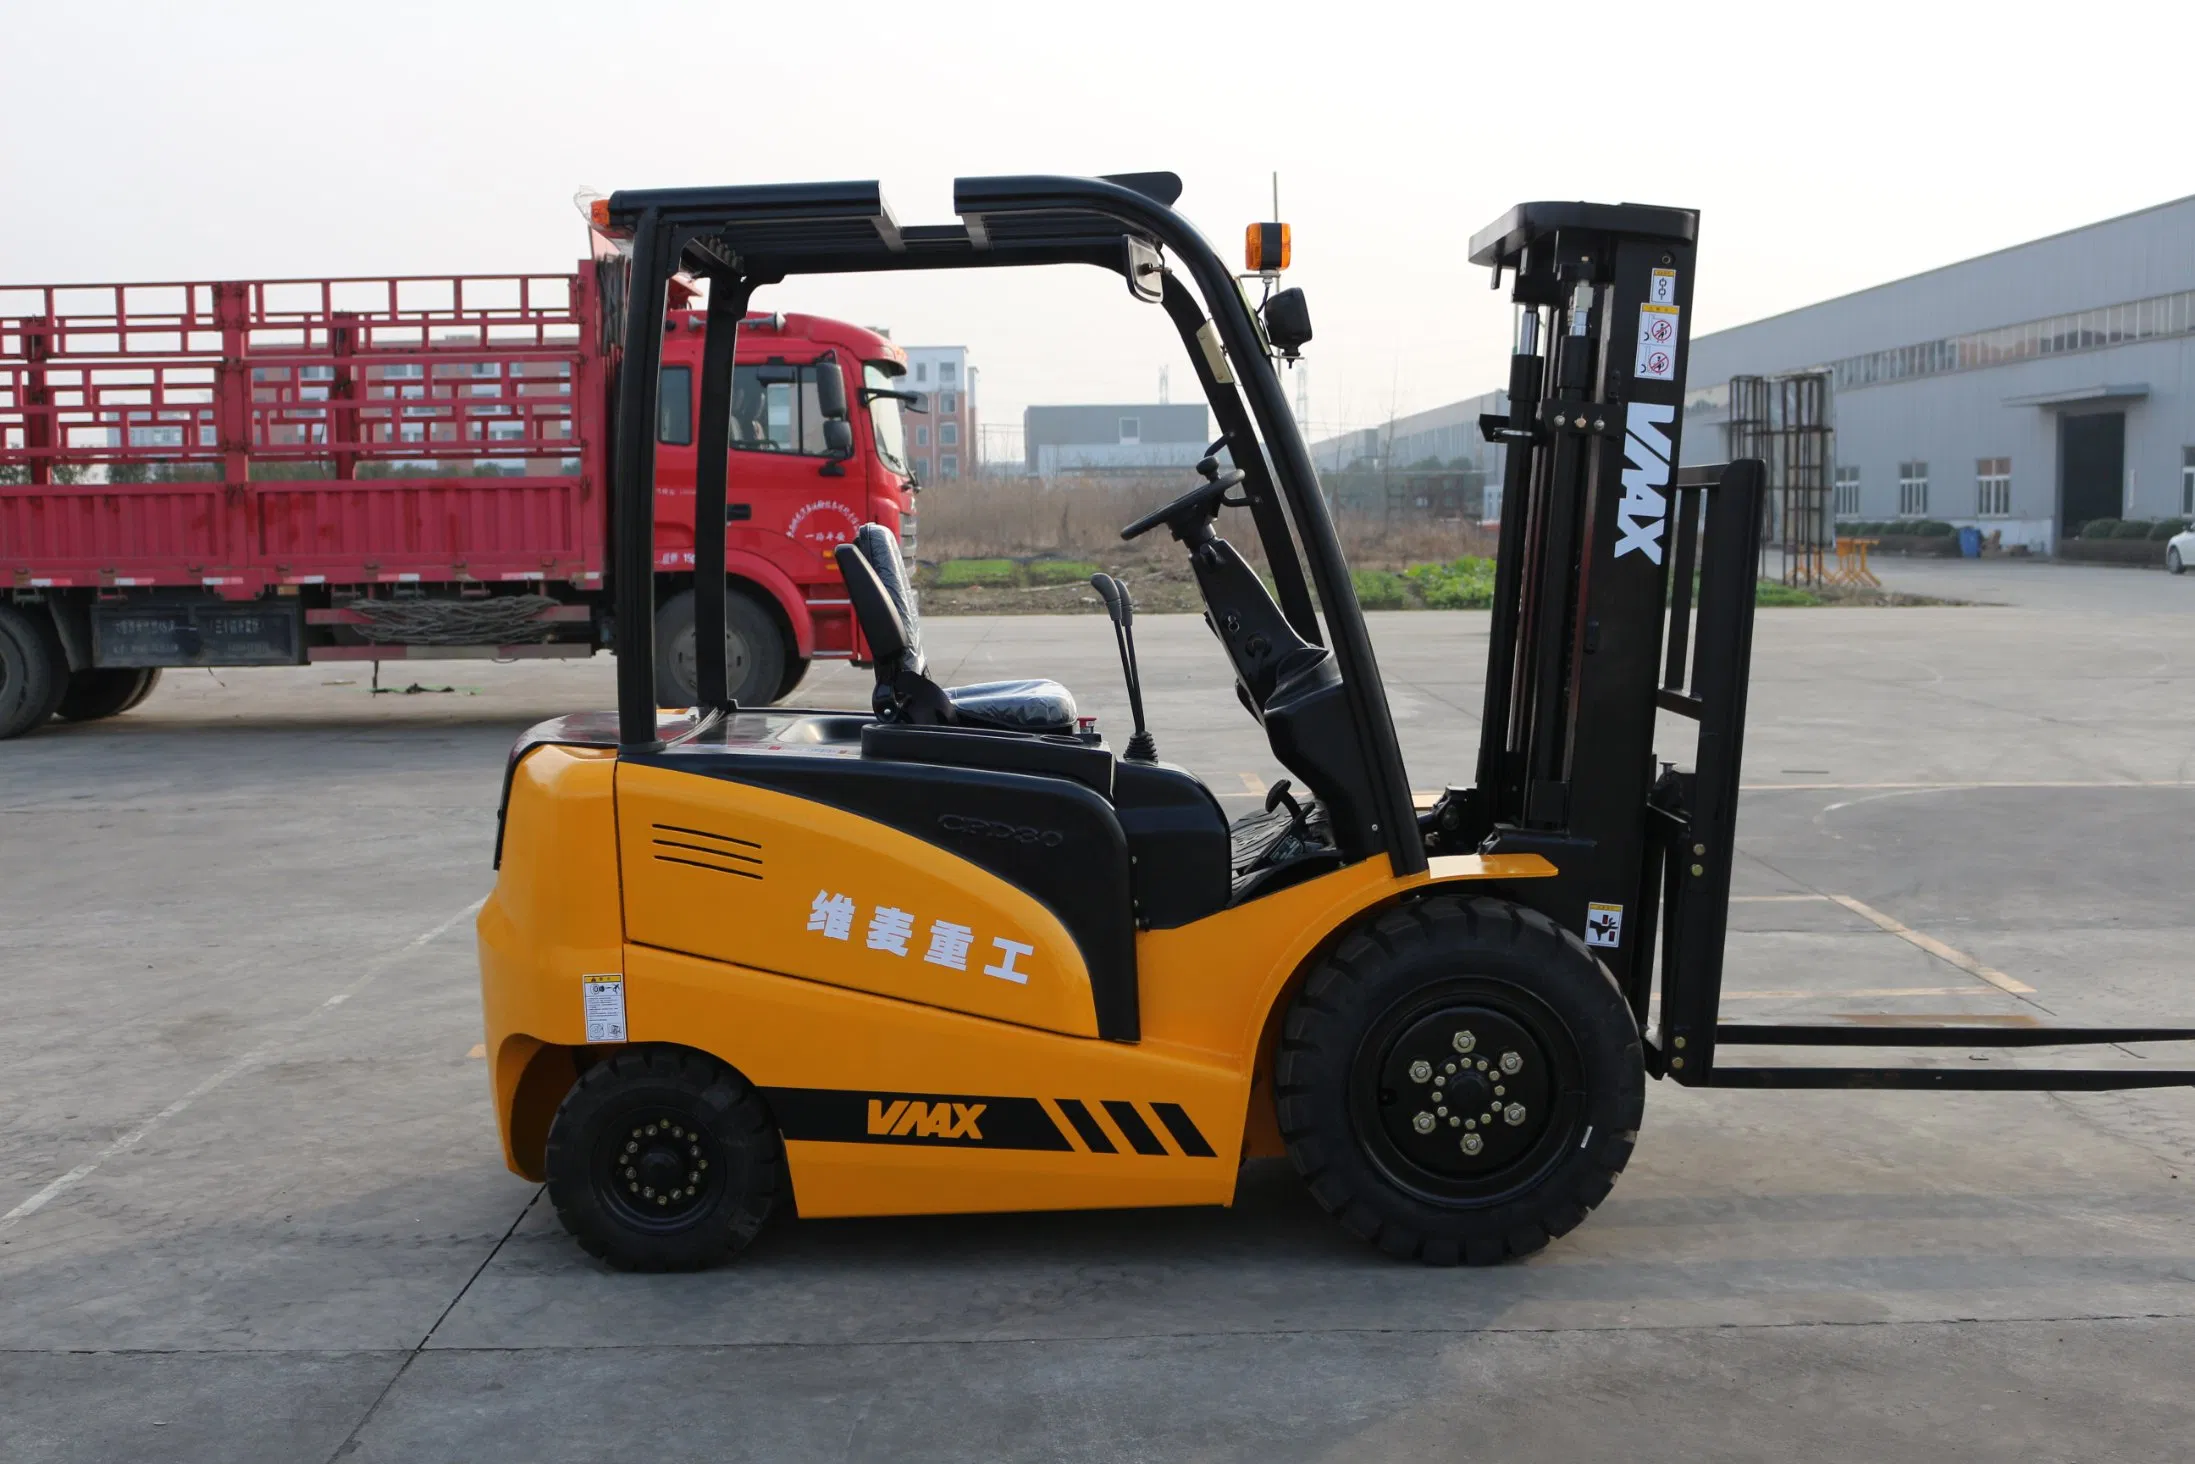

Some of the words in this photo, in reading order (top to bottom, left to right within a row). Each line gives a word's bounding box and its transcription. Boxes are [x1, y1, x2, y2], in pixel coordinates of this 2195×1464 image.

[1614, 402, 1675, 566] VMAX
[806, 889, 1034, 985] 维麦重工
[867, 1099, 987, 1140] VMAX
